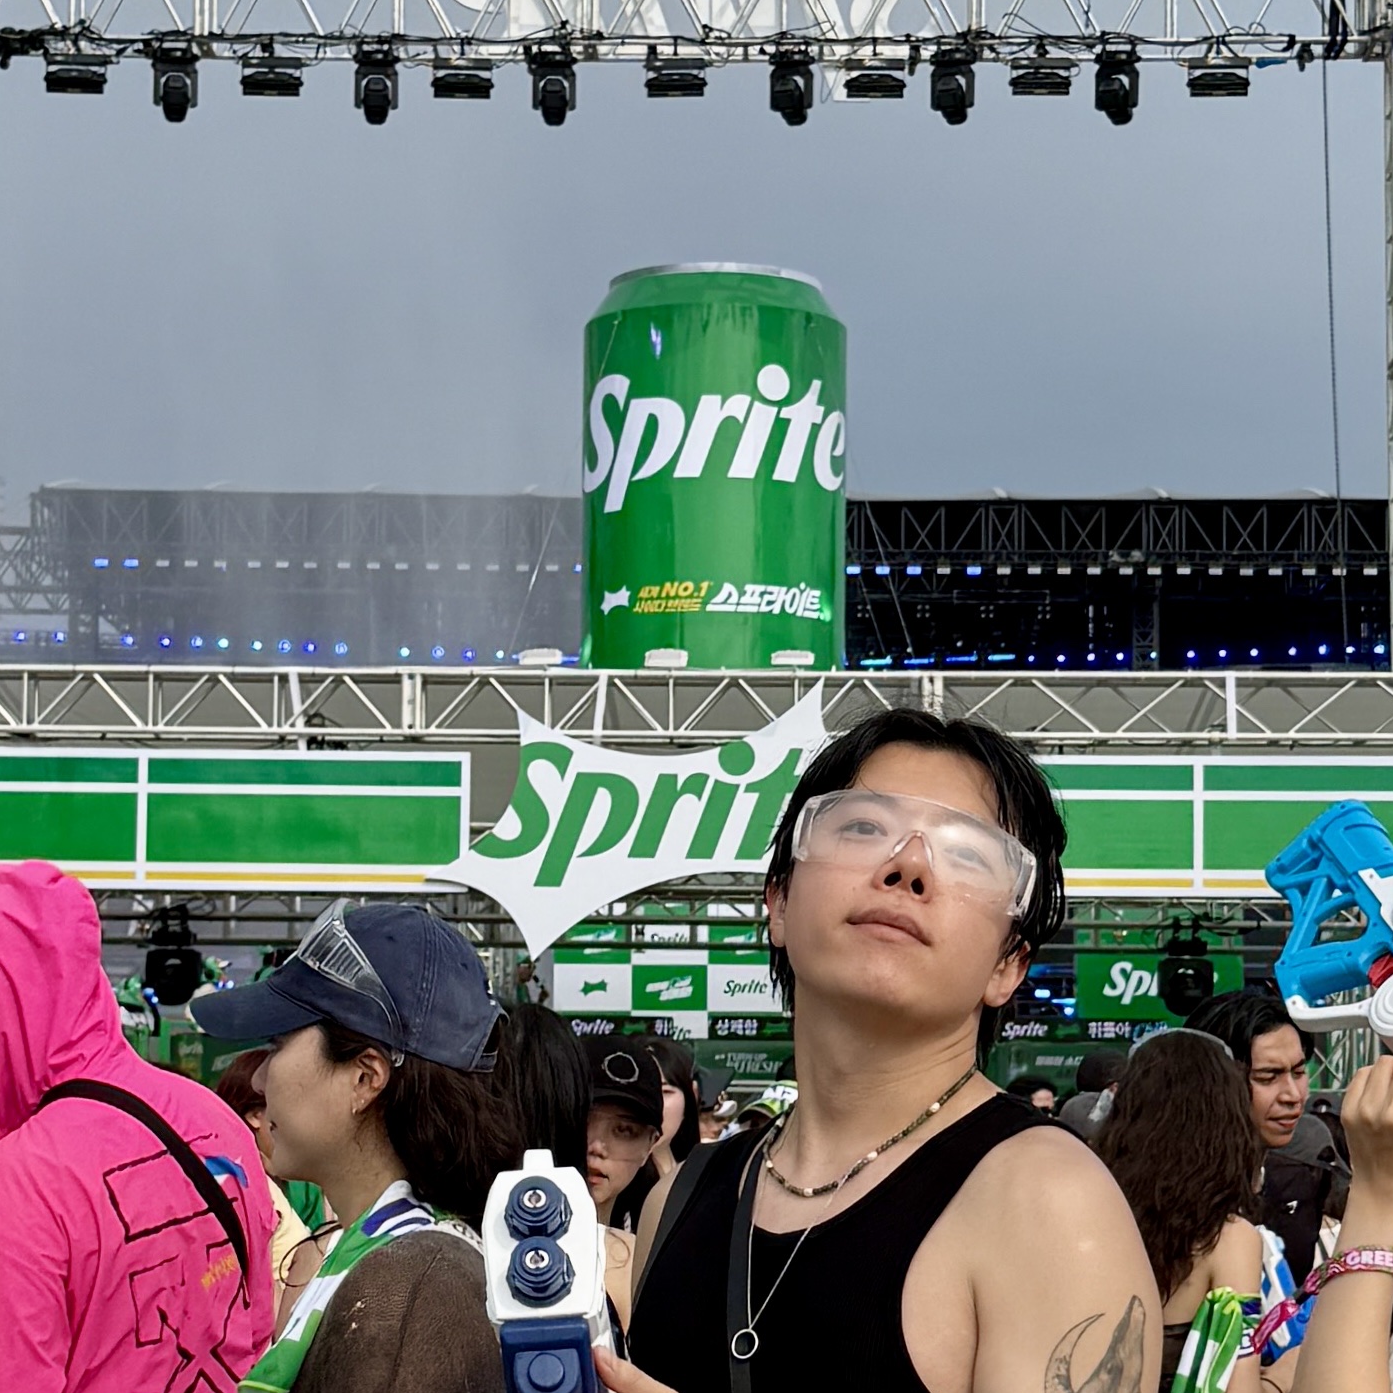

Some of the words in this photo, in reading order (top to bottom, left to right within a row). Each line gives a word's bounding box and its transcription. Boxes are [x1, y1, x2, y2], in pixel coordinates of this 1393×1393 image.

[582, 364, 845, 514] Sprite
[470, 741, 805, 888] Sprit
[723, 979, 768, 997] Sprite
[571, 1018, 615, 1037] Sprite
[1001, 1021, 1049, 1038] Sprite
